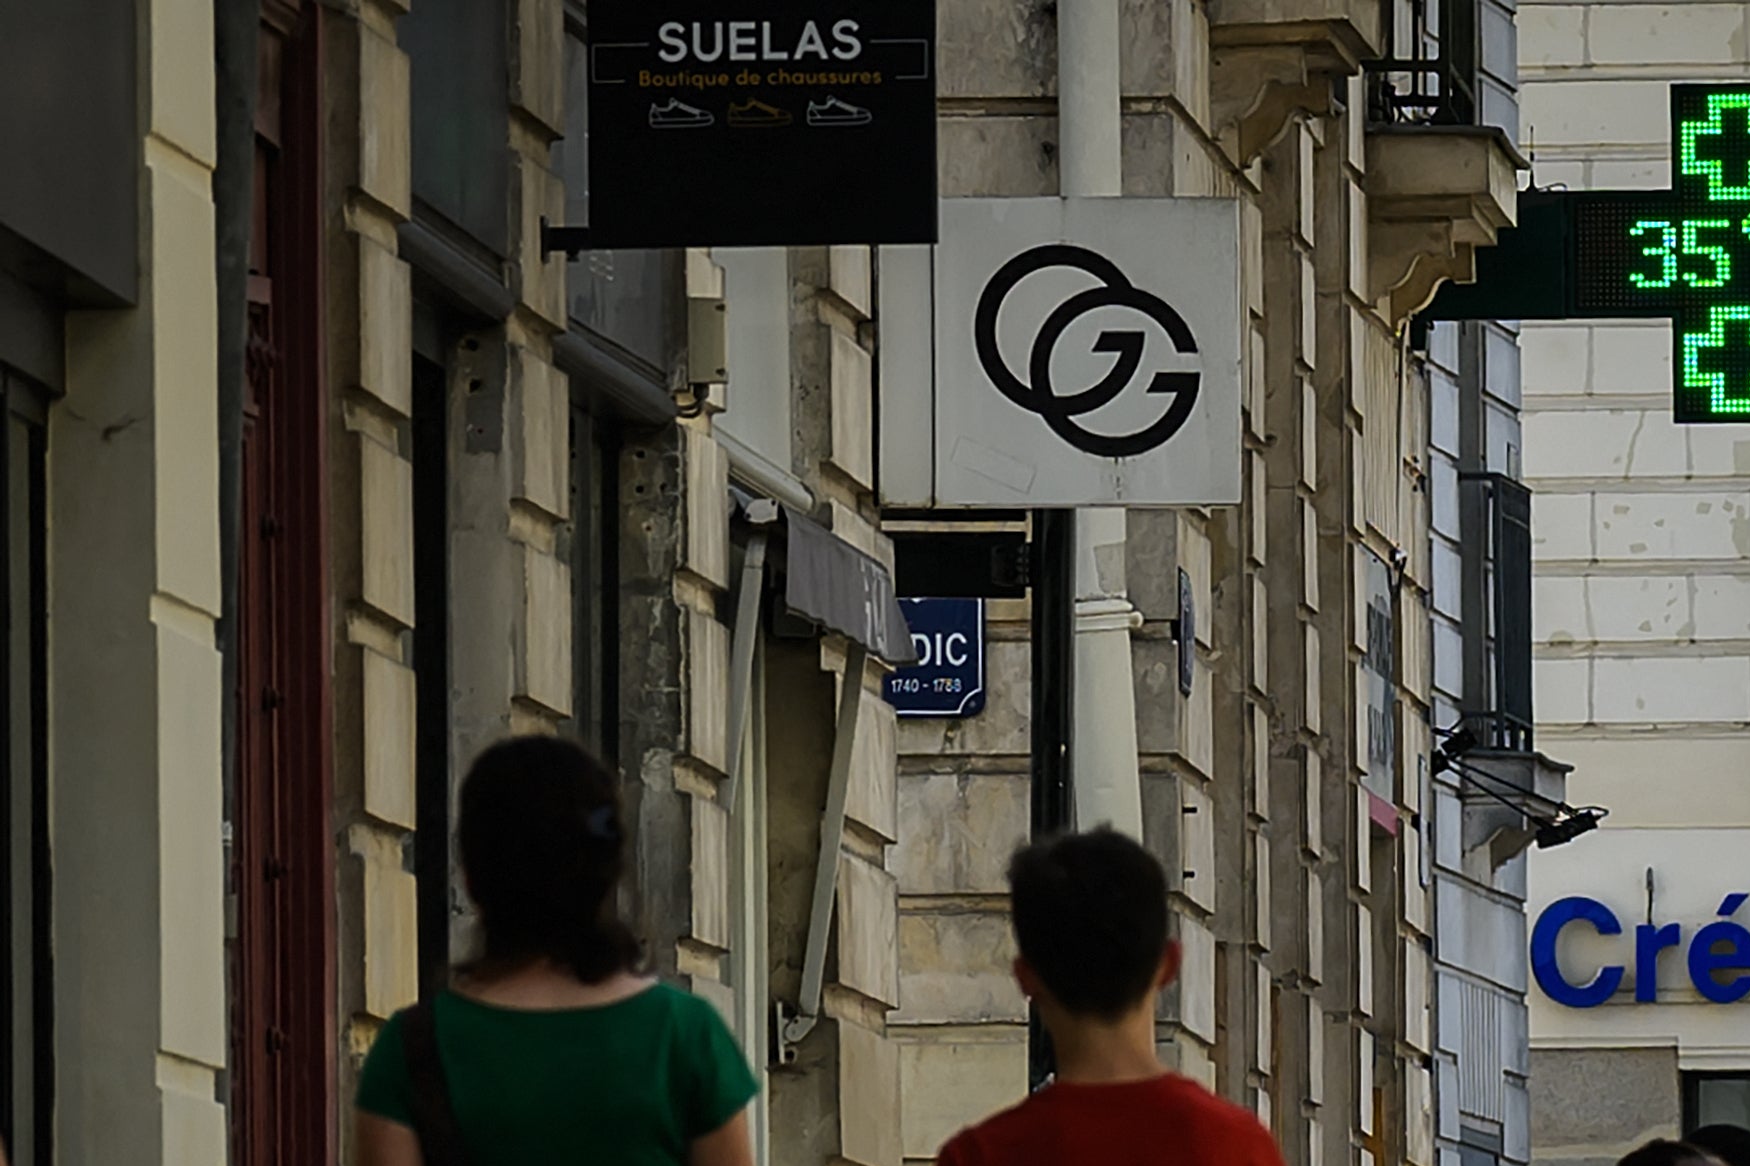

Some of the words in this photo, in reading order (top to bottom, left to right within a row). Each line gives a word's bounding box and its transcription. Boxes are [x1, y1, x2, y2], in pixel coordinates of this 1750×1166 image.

[658, 19, 862, 62] SUELAS
[639, 70, 729, 89] Boutique
[735, 68, 761, 85] de
[767, 67, 883, 86] chaussures
[891, 677, 920, 693] 1740
